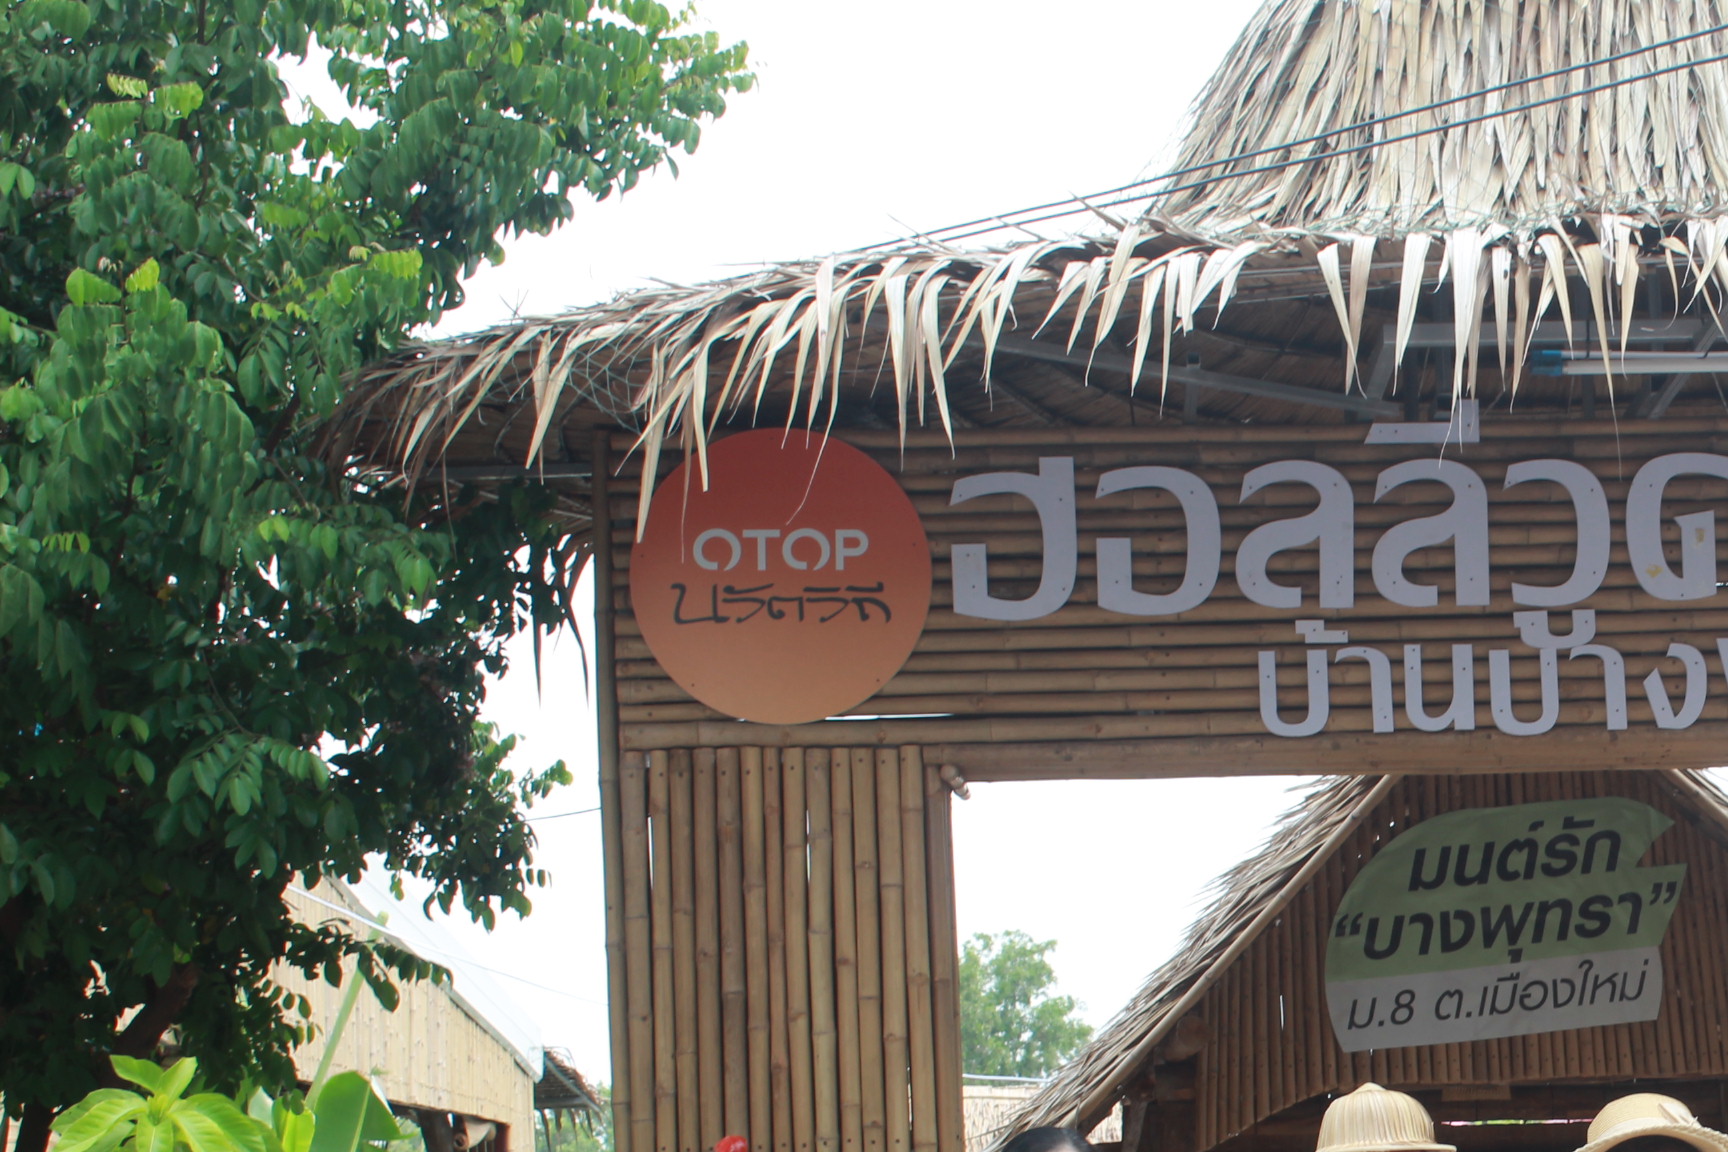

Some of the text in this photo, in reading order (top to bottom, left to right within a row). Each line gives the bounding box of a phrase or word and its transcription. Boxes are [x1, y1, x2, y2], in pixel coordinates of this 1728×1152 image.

[693, 528, 869, 571] OTOP
[1408, 816, 1622, 891] มนต์รัก
[1334, 881, 1678, 964] “บางพุทรา”
[1347, 958, 1650, 1030] ม.8 ต.เมืองใหม่
